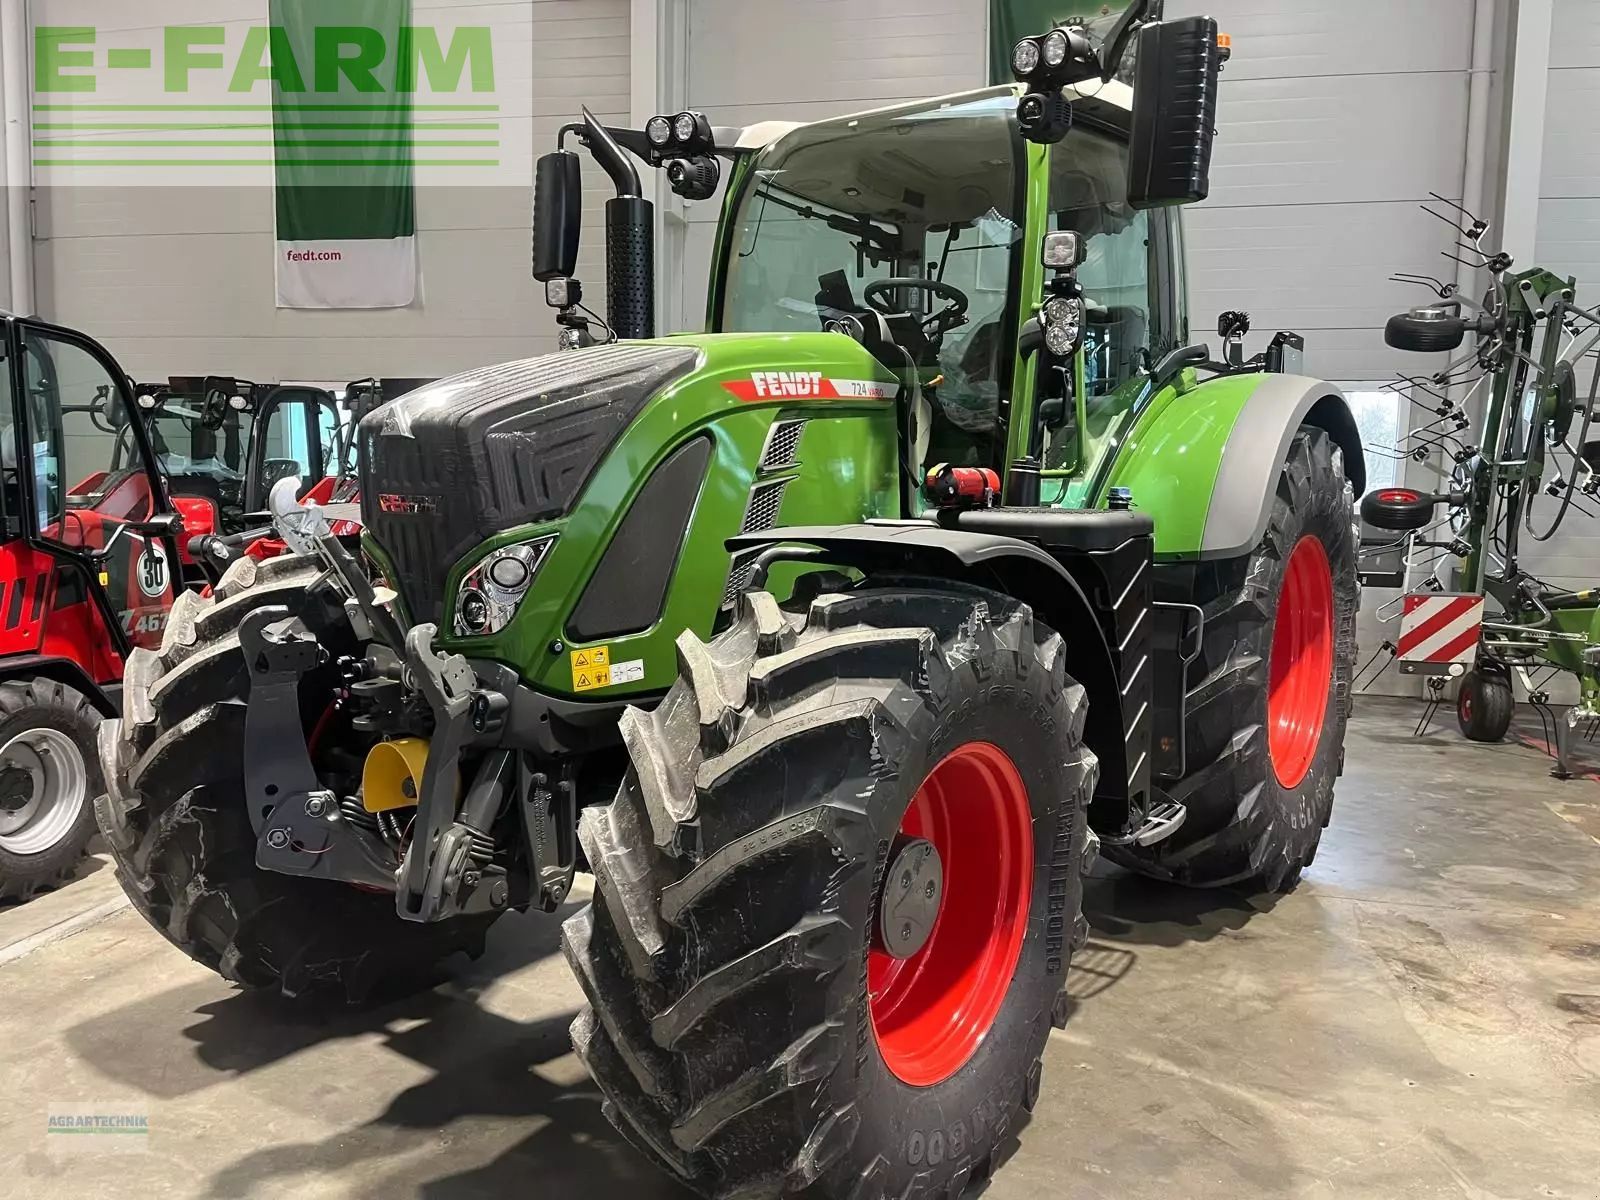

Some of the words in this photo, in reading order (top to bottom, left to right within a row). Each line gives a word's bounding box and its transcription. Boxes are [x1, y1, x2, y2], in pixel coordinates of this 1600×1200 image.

[286, 250, 342, 261] fendt.com
[751, 371, 822, 397] FENDT
[851, 382, 867, 397] 724
[143, 556, 164, 589] 30
[1045, 796, 1075, 976] TRELLEBORG
